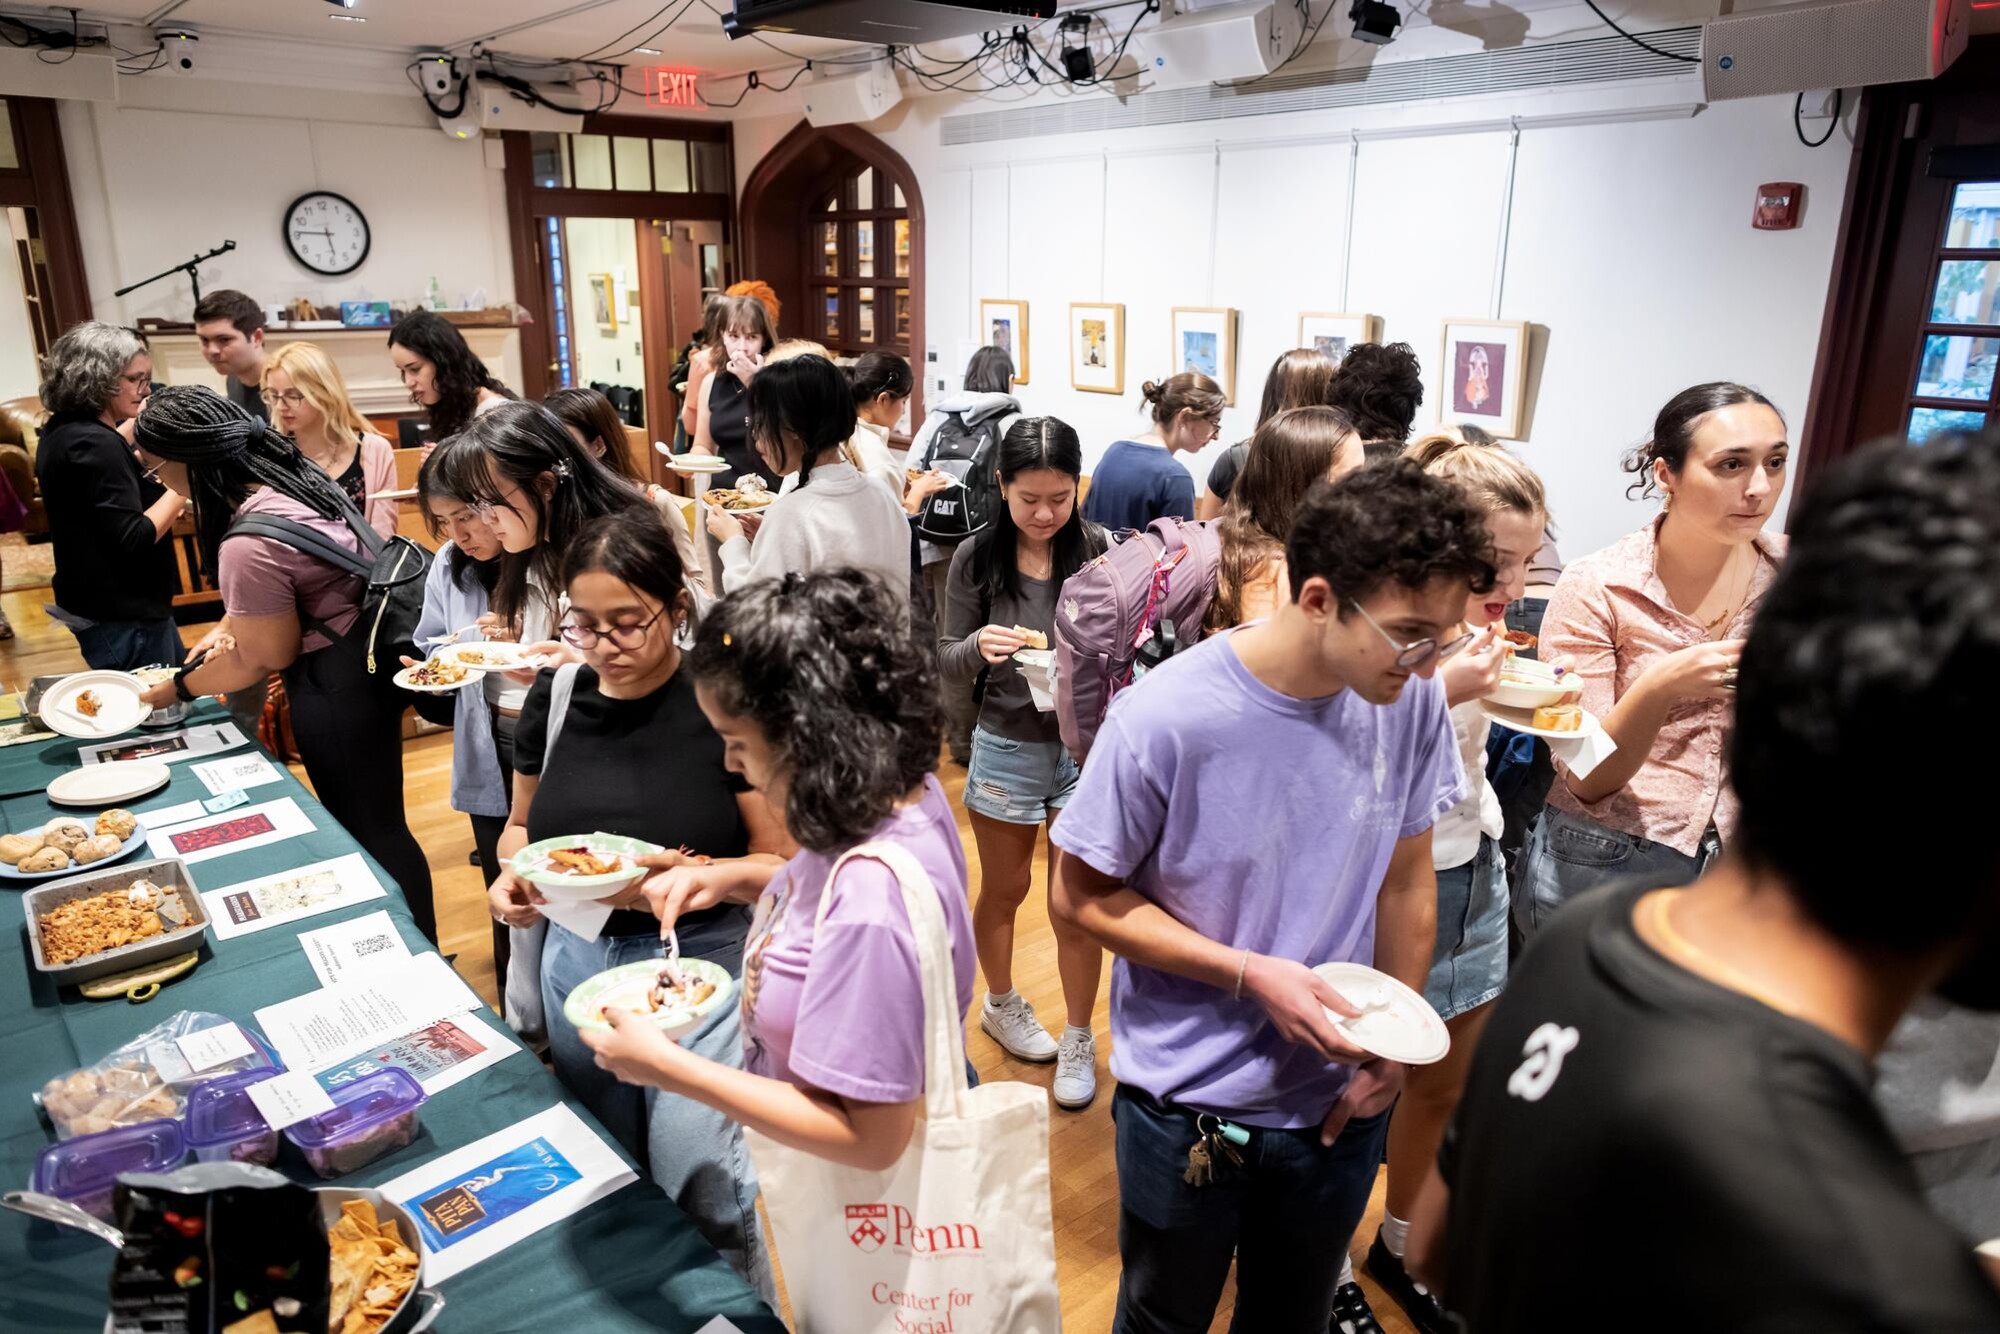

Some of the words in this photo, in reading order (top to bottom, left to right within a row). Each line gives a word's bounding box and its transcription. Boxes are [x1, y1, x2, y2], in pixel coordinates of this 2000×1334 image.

[659, 71, 697, 106] EXIT
[303, 206, 314, 215] 11
[317, 200, 327, 211] 12
[334, 205, 340, 214] 1
[296, 216, 307, 226] 10
[345, 213, 353, 223] 2
[353, 227, 360, 238] 3
[301, 244, 309, 255] 8
[351, 242, 358, 251] 4
[315, 253, 322, 263] 7
[329, 256, 337, 266] 6
[342, 251, 350, 262] 5
[933, 499, 959, 516] CAT
[448, 1194, 476, 1217] PAN
[433, 1201, 462, 1229] PITA
[892, 1204, 984, 1252] Penn
[872, 1281, 940, 1311] Center
[947, 1287, 975, 1313] for
[895, 1310, 954, 1334] Social
